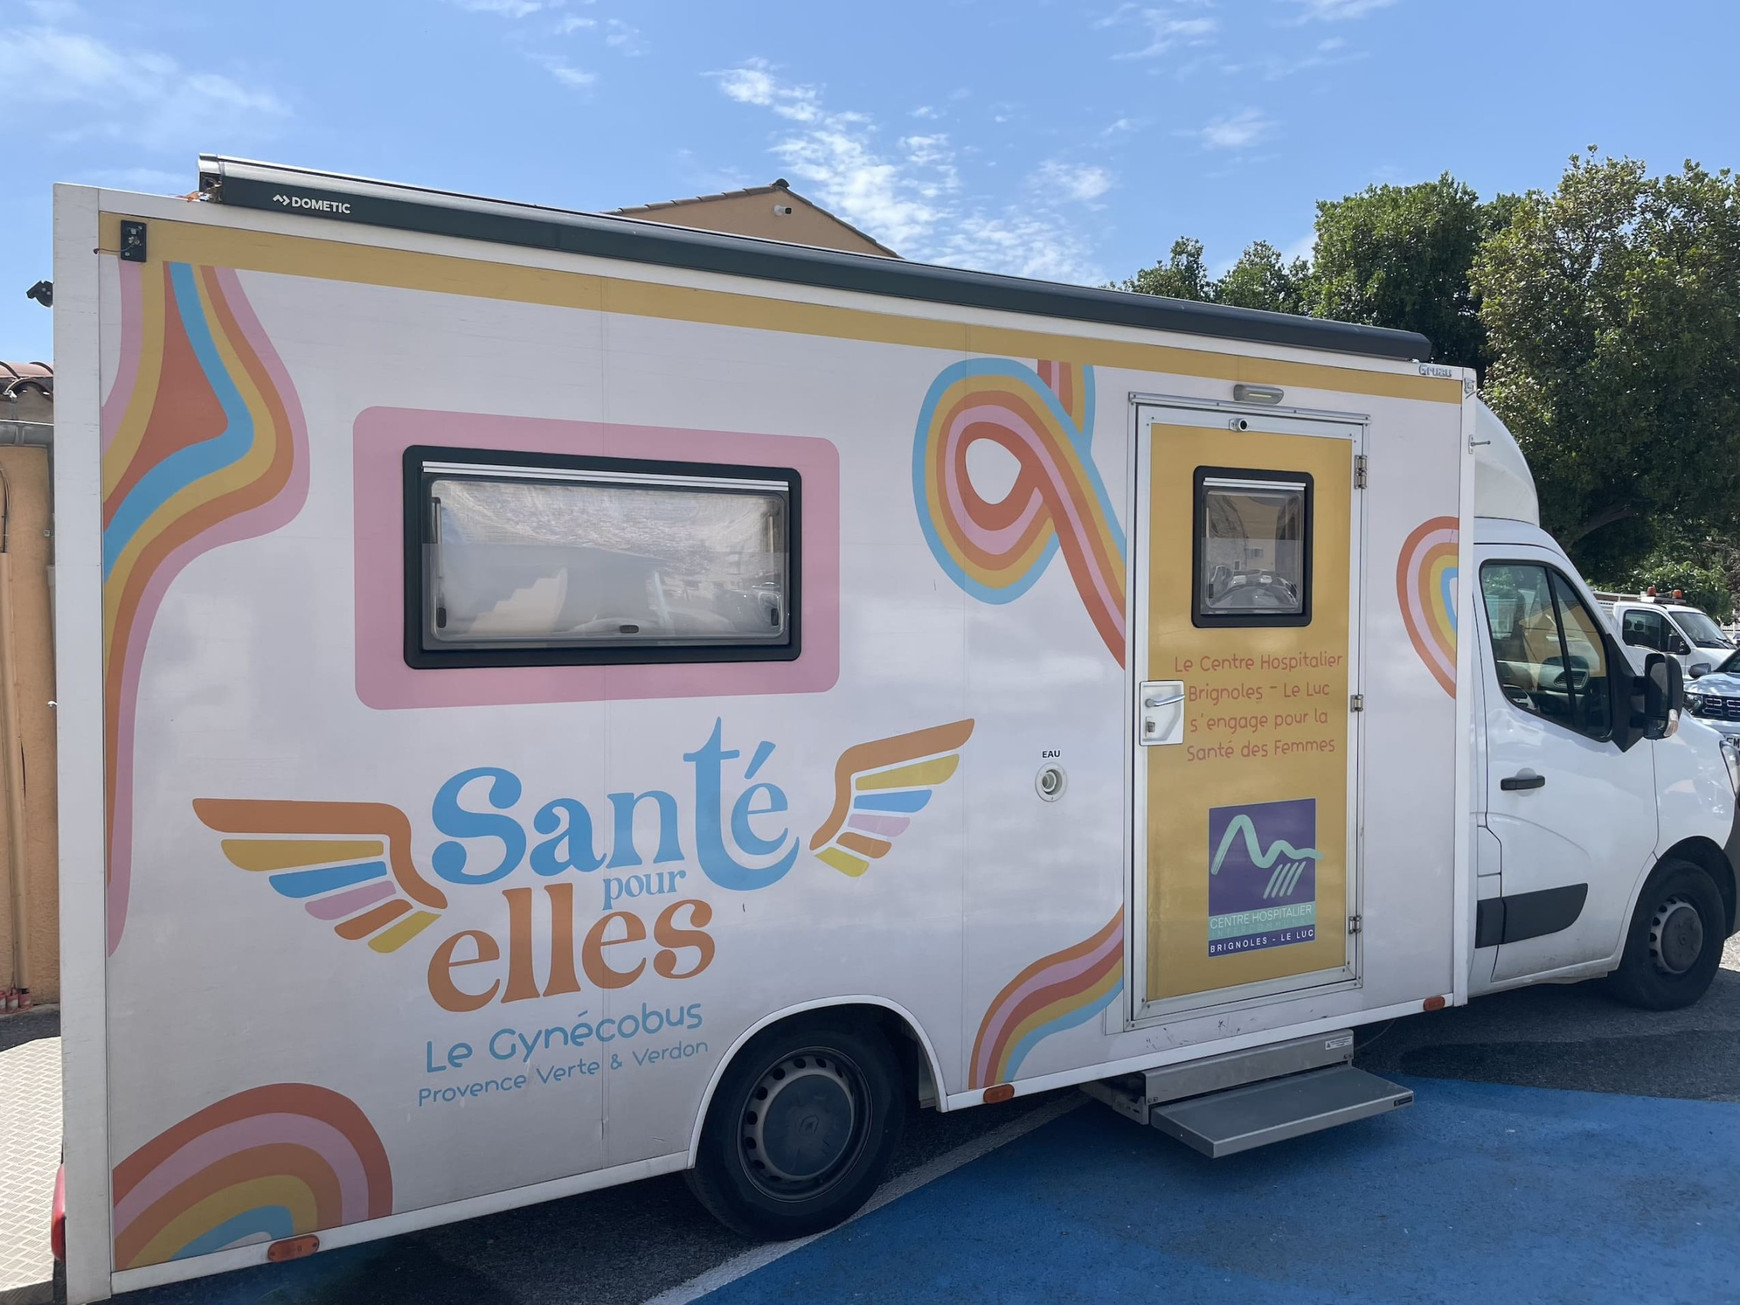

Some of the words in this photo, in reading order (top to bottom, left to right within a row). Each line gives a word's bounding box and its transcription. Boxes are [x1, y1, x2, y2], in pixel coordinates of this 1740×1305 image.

[291, 196, 351, 214] DOMETIC
[1175, 656, 1193, 673] Le
[1200, 653, 1255, 672] Centre
[1260, 651, 1343, 672] Hospitalier
[1188, 683, 1263, 706] Brignoles
[1283, 682, 1300, 698] Le
[1306, 682, 1330, 697] Luc
[1190, 713, 1268, 735] s'engage
[1274, 711, 1309, 730] pour
[1314, 708, 1328, 725] la
[1042, 750, 1061, 758] EAU
[1187, 741, 1235, 762] Santé
[1240, 740, 1268, 758] des
[1274, 738, 1335, 755] Femmes
[431, 716, 800, 892] Santé
[602, 868, 686, 911] pour
[1210, 914, 1249, 929] CENTRE
[1252, 905, 1312, 922] HOSPITALIER
[427, 882, 716, 1013] elles
[1210, 936, 1267, 953] BRIGNOLES
[1281, 932, 1292, 942] LE
[1296, 929, 1314, 940] LUC
[426, 1041, 473, 1073] Le
[488, 1002, 703, 1063] Gynécobus
[418, 1074, 527, 1107] Provence
[536, 1058, 600, 1084] Verte
[610, 1053, 623, 1071] &
[632, 1040, 709, 1067] Verdon
